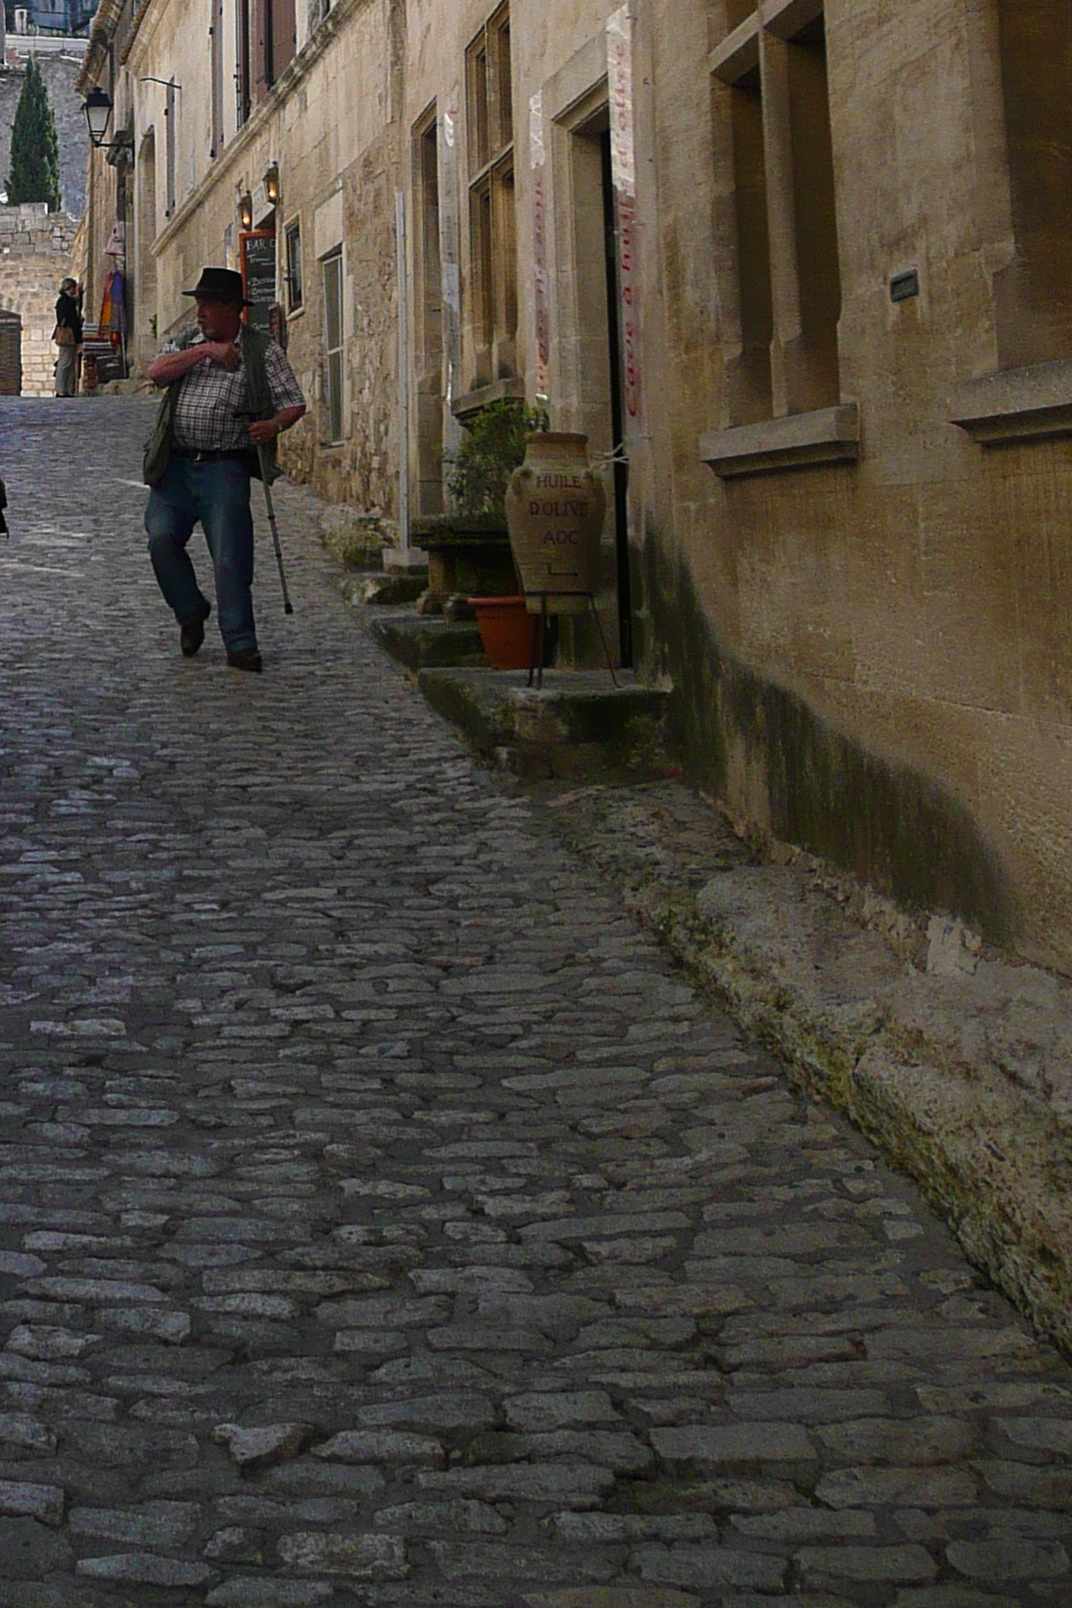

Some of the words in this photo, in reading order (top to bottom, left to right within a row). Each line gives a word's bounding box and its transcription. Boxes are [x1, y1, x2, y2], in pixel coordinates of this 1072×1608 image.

[625, 320, 638, 418] Cave
[536, 475, 582, 489] HUILE
[543, 530, 578, 545] AOC
